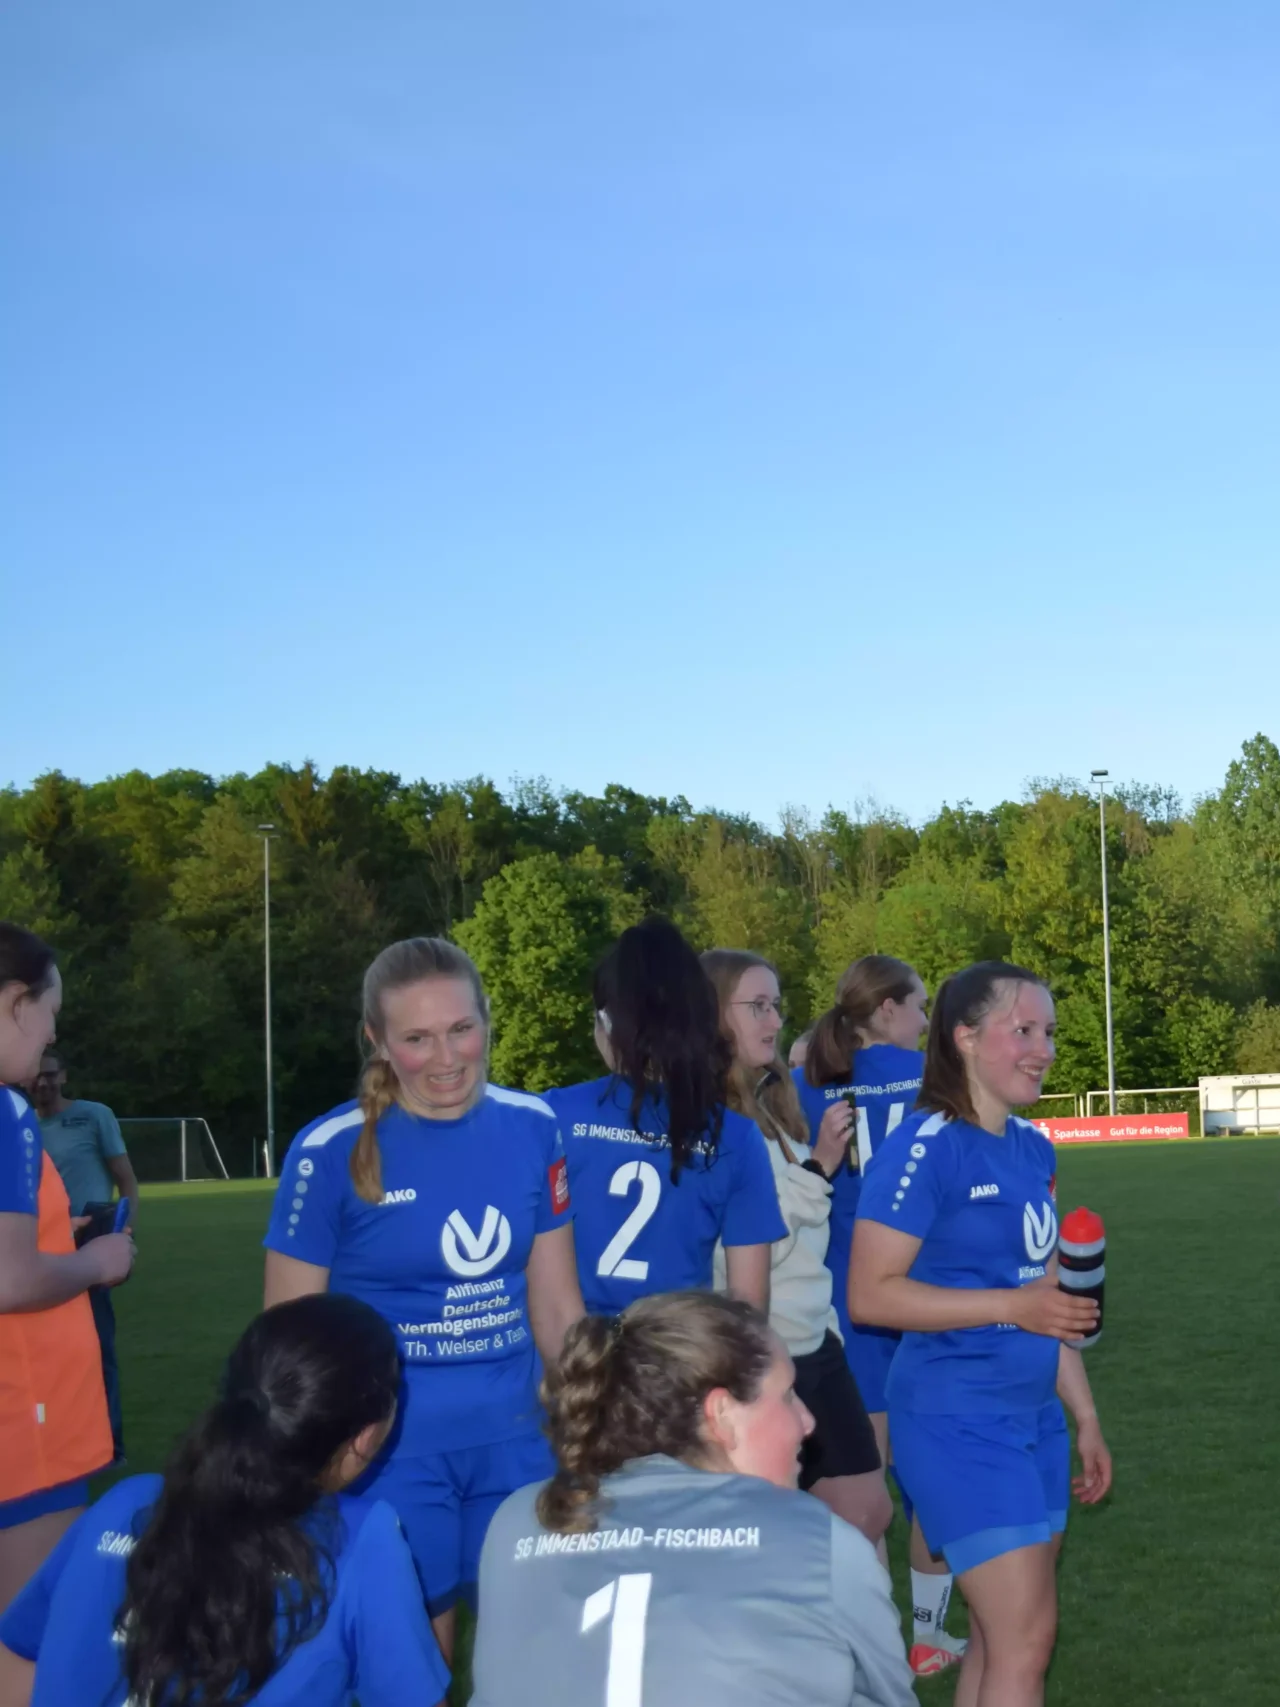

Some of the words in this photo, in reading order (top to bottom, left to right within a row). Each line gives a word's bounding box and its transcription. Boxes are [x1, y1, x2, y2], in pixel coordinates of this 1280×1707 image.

[825, 1089, 835, 1099] SG
[573, 1124, 587, 1136] SG
[1053, 1129, 1101, 1140] Sparkasse
[1109, 1127, 1125, 1136] Gut
[1126, 1126, 1139, 1135] für
[1139, 1126, 1153, 1134] die
[1154, 1125, 1184, 1135] Region
[378, 1188, 417, 1205] AKO
[970, 1184, 999, 1198] JAKO
[596, 1160, 661, 1280] 2
[446, 1278, 504, 1300] Allfinanz
[443, 1294, 510, 1317] Deutsche
[405, 1341, 432, 1356] Th.
[437, 1337, 490, 1355] Welser
[493, 1333, 503, 1348] &
[514, 1537, 534, 1560] SG
[535, 1527, 761, 1556] IMMENSTAAD-FISCHBACH
[579, 1572, 653, 1707] 1
